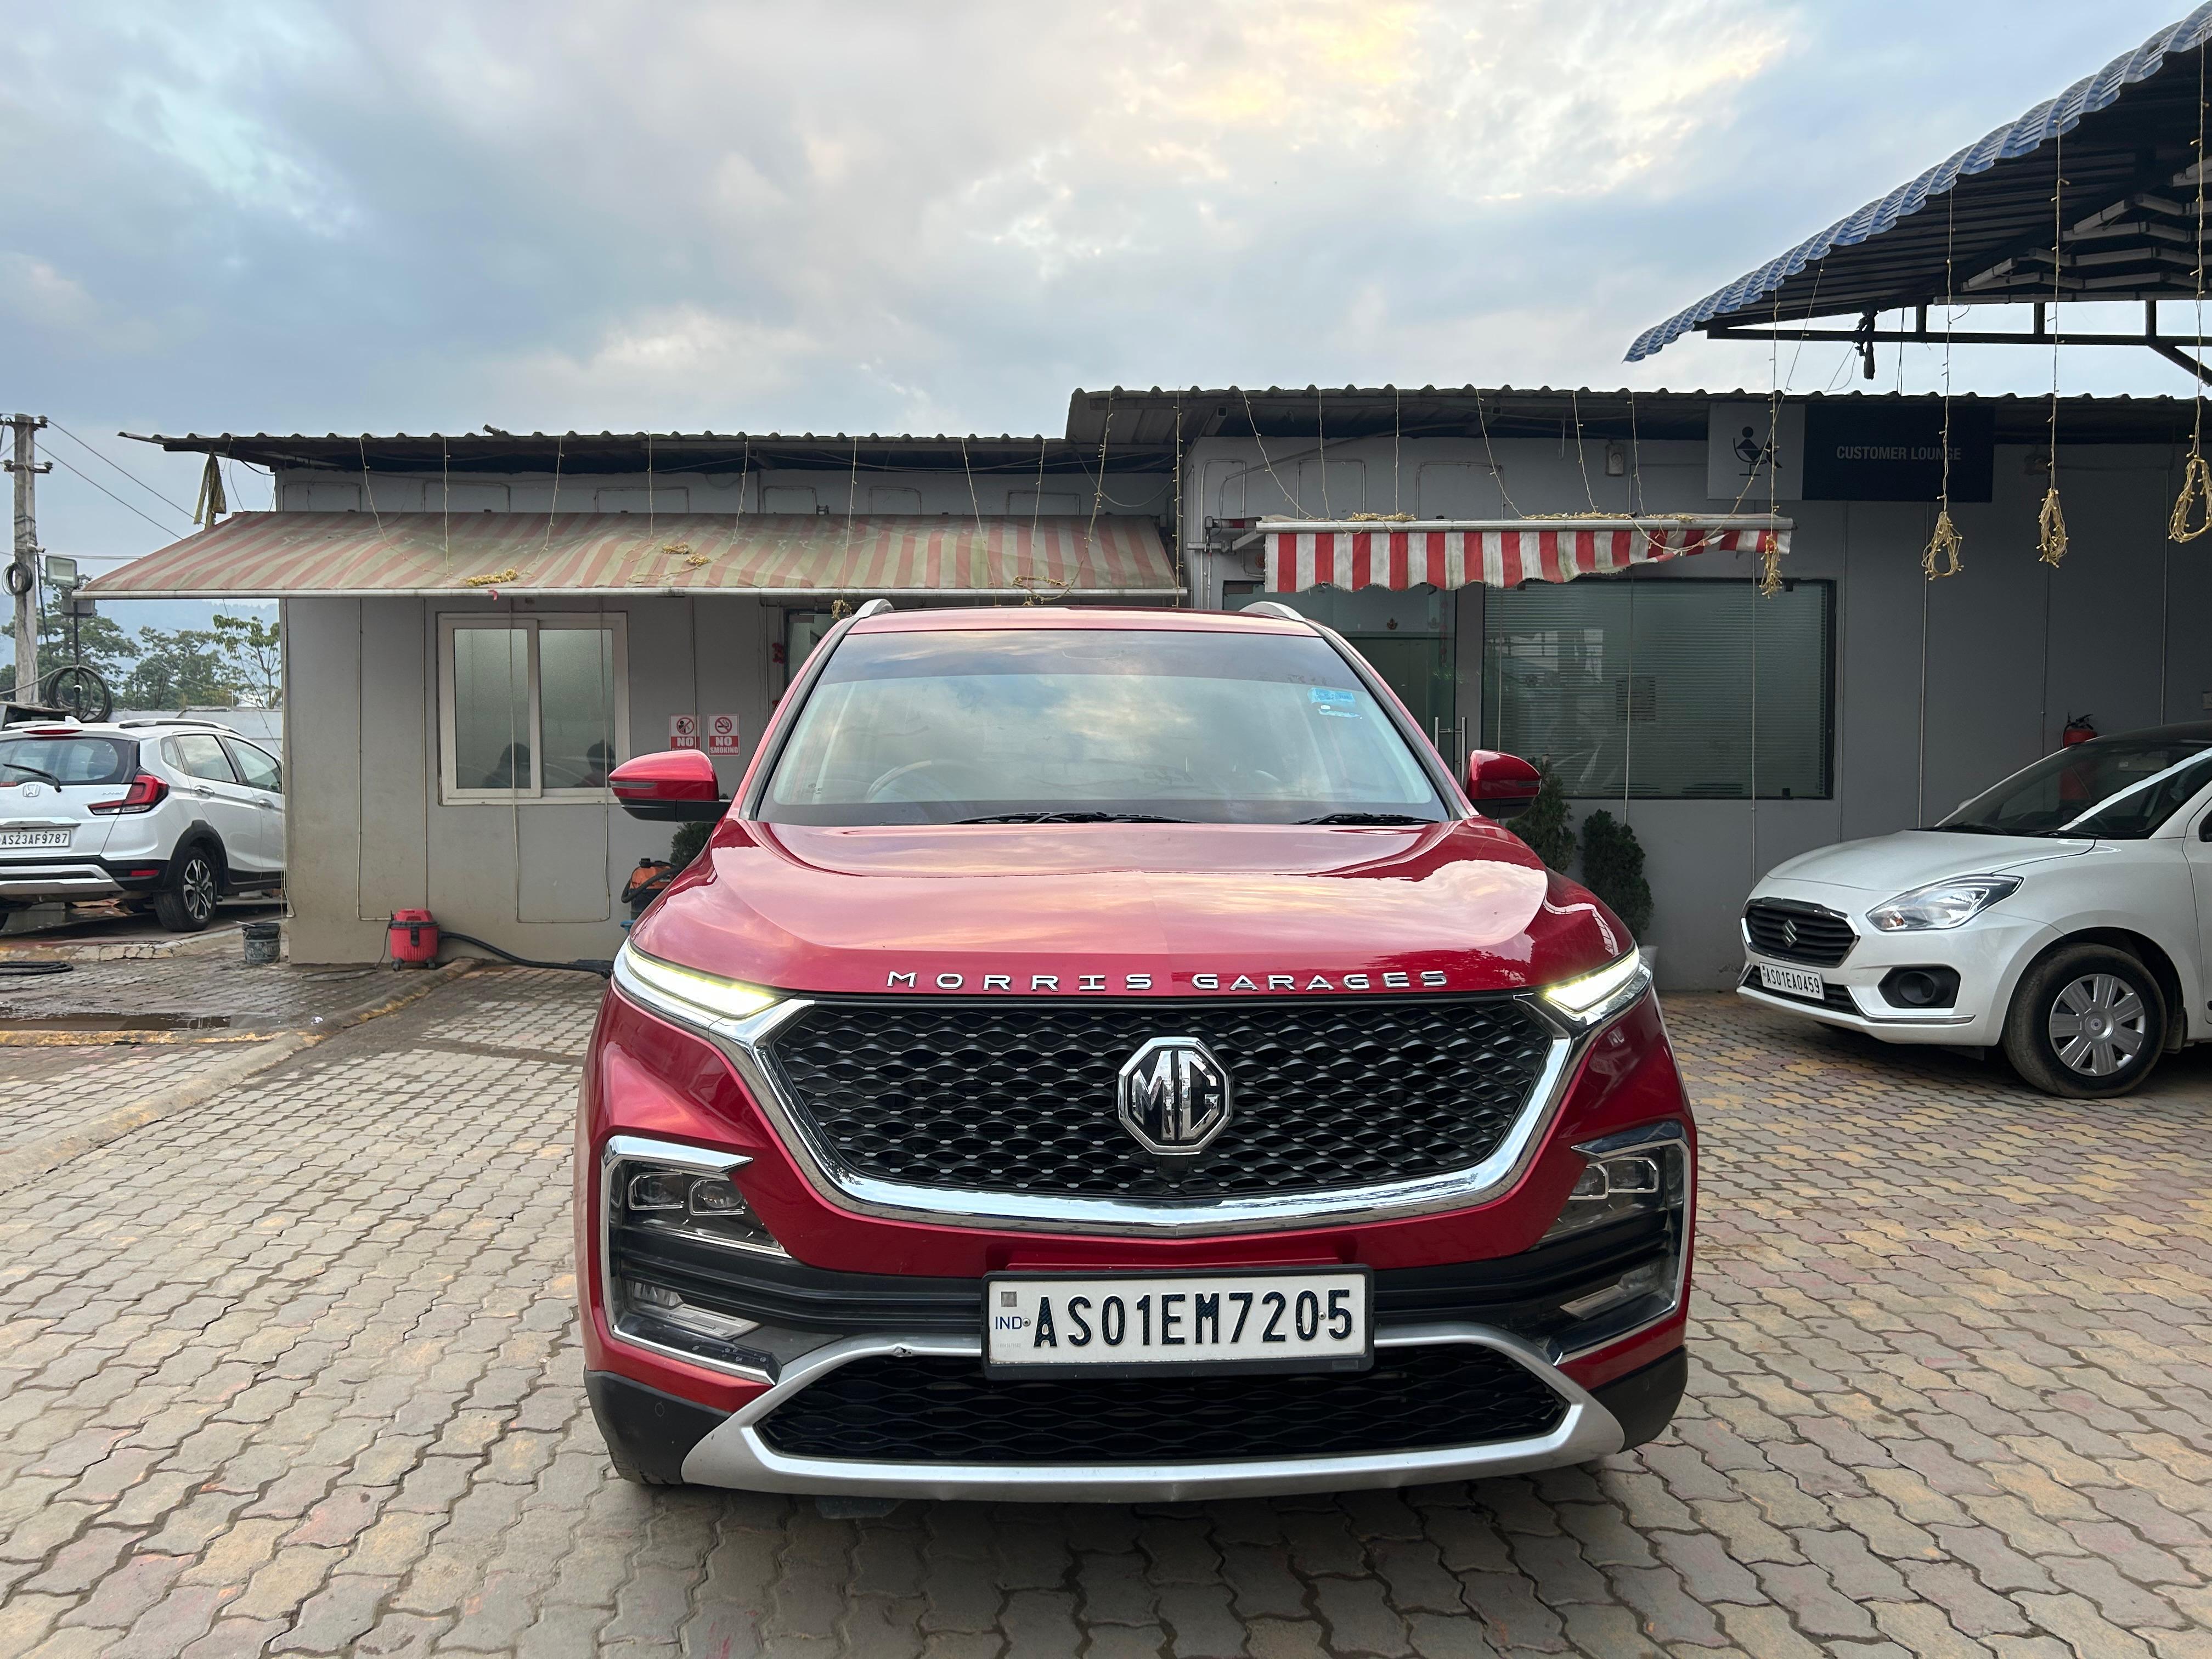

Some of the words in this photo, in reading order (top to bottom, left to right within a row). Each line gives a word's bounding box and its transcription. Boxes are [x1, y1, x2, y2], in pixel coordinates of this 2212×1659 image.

[1836, 445, 1906, 460] CUSTOMER
[1911, 447, 1961, 460] LOUNGE
[676, 737, 694, 747] NO
[715, 737, 732, 746] NO
[1, 833, 67, 845] AS23AF9787
[887, 970, 1153, 991] MORRIS
[1192, 970, 1448, 991] GARAGES
[1766, 968, 1820, 994] AS01EA0459
[1132, 1050, 1220, 1140] MG
[995, 1316, 1022, 1330] IND
[1033, 1289, 1353, 1348] AS01EM7205
